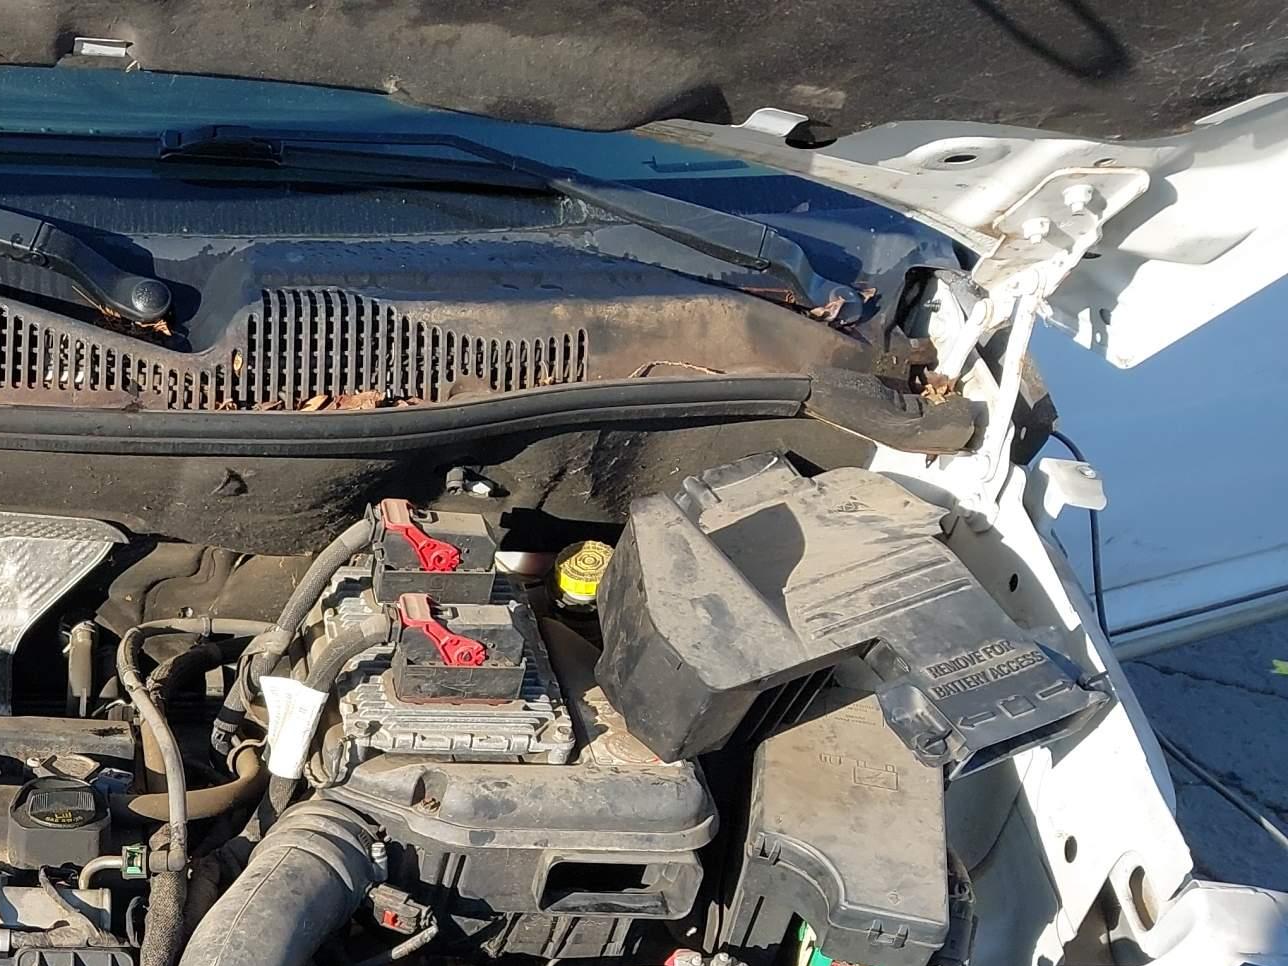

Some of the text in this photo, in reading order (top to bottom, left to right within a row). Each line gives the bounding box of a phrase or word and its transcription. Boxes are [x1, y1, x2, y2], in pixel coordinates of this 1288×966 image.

[925, 640, 1016, 678] REMOVE FOR
[931, 651, 1045, 699] BATTERY ACCESS
